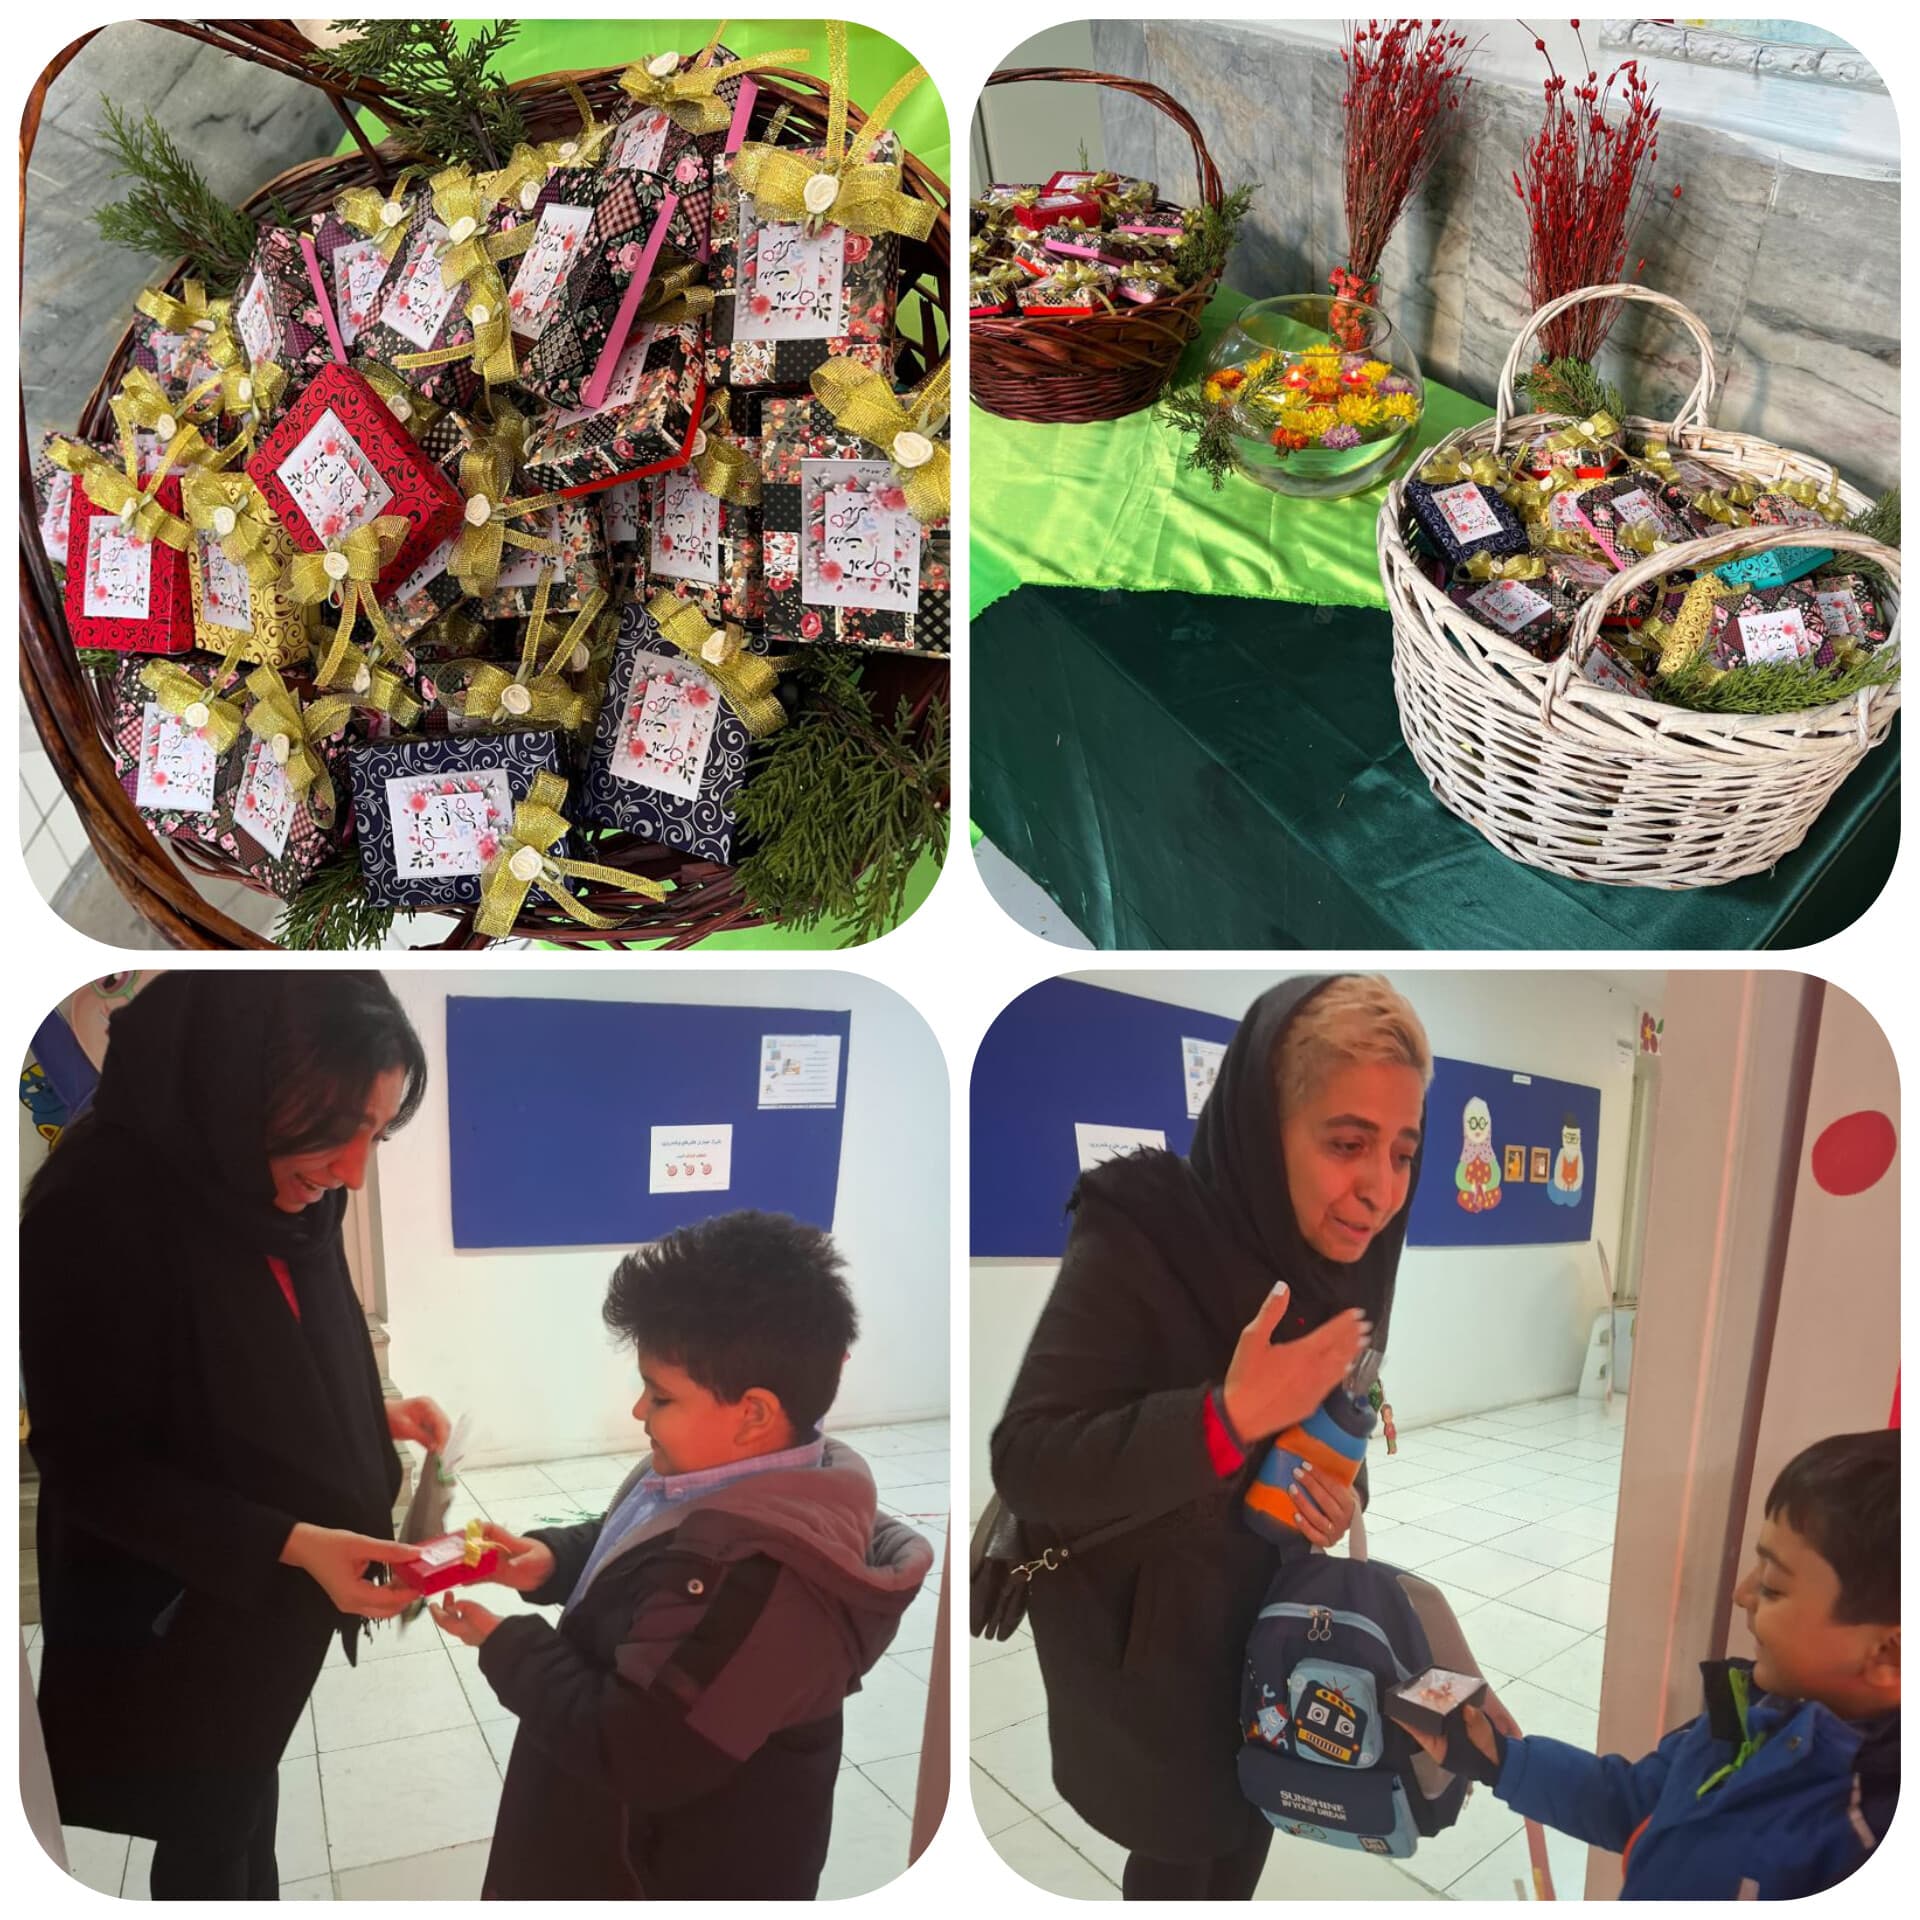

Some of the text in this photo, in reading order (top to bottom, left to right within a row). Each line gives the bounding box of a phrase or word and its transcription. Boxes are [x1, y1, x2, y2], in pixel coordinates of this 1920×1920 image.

[842, 497, 869, 532] مبارک
[828, 536, 863, 552] روزت
[848, 545, 878, 572] مادرم
[1280, 1790, 1345, 1813] SUNSHINE
[1281, 1799, 1347, 1821] IN YOUR DREAM
